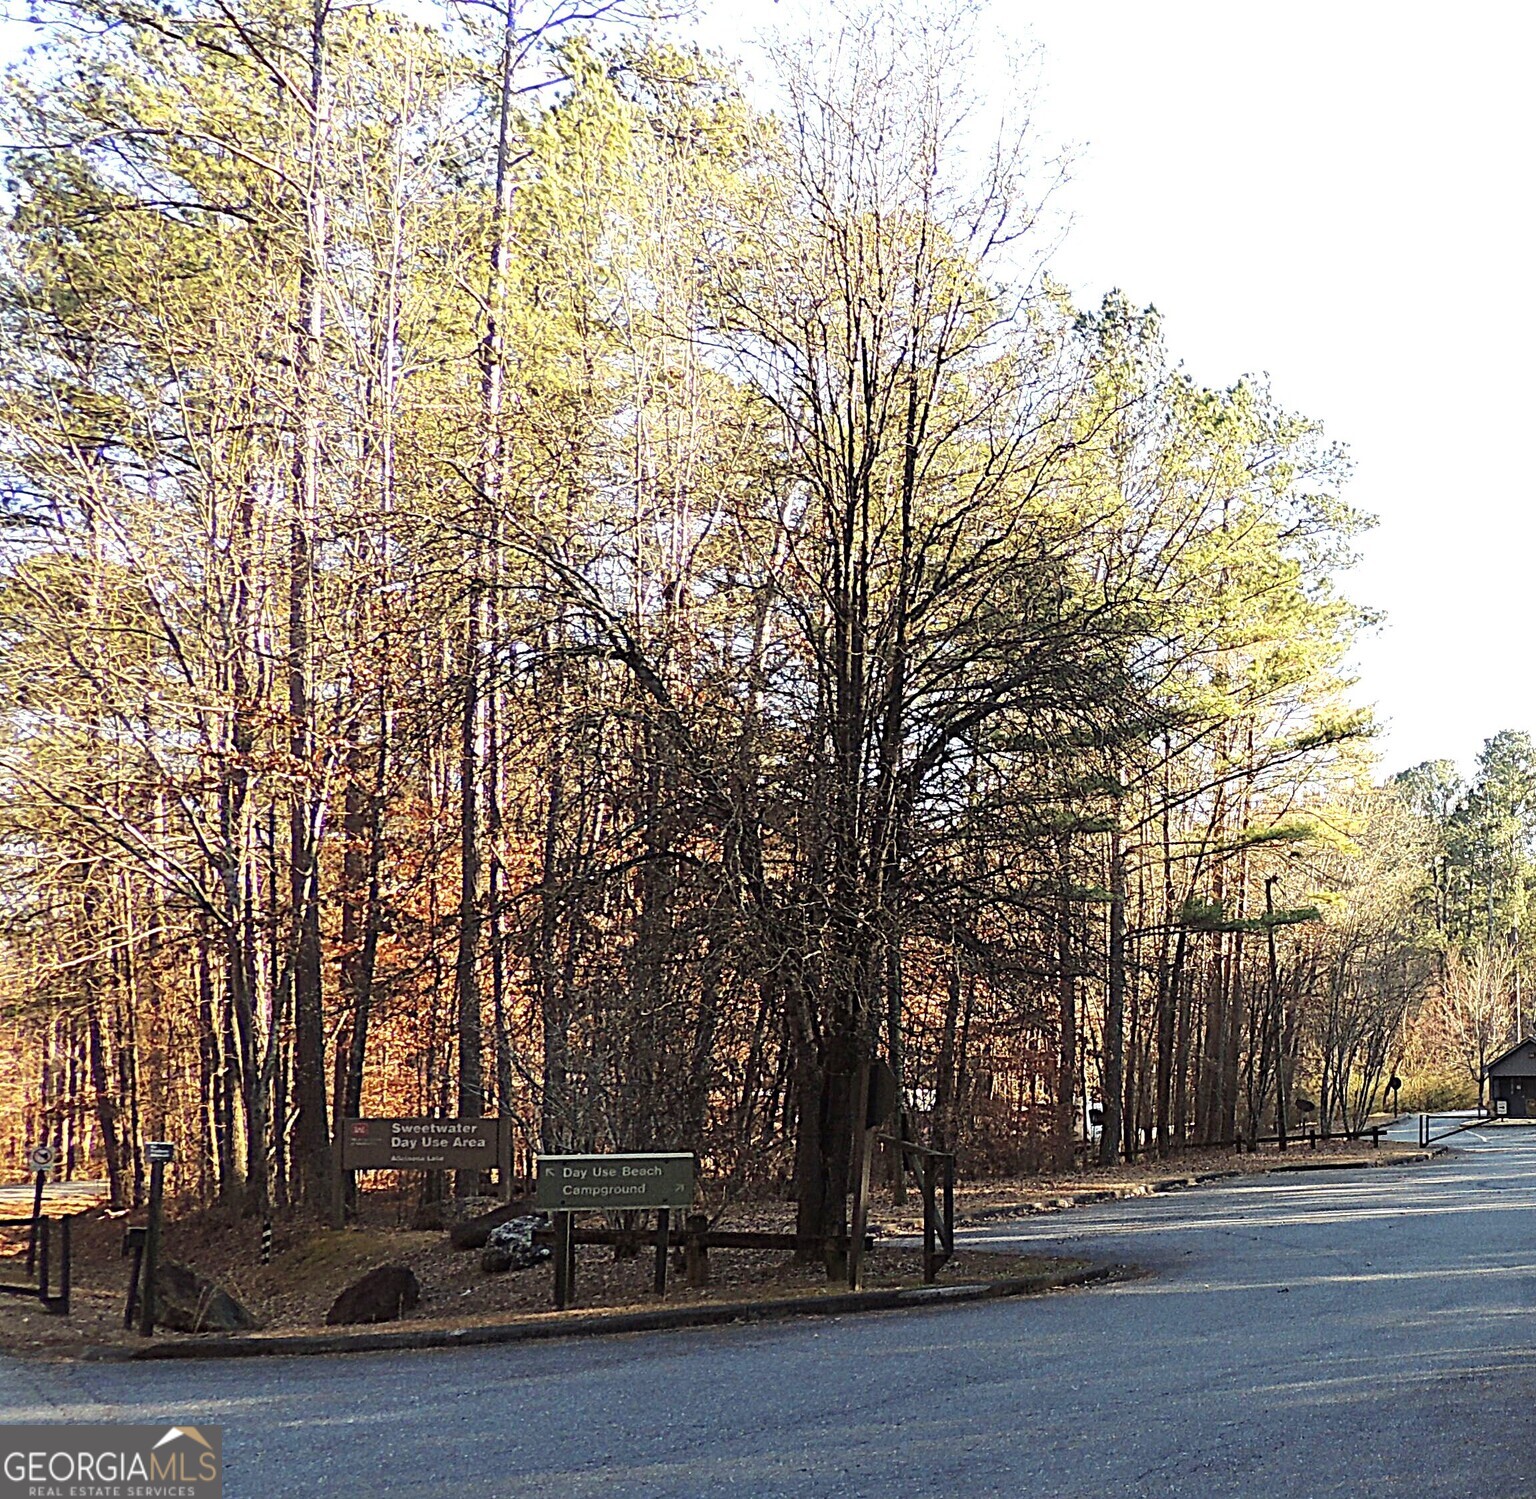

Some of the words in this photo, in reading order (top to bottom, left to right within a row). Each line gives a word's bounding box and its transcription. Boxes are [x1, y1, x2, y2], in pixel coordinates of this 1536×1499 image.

[391, 1122, 478, 1134] Sweetwater
[391, 1136, 418, 1149] Day
[421, 1136, 449, 1148] Use
[452, 1137, 486, 1148] Area
[563, 1167, 587, 1179] Day
[592, 1167, 617, 1177] Use
[622, 1165, 663, 1177] Beach
[562, 1183, 646, 1197] Campground
